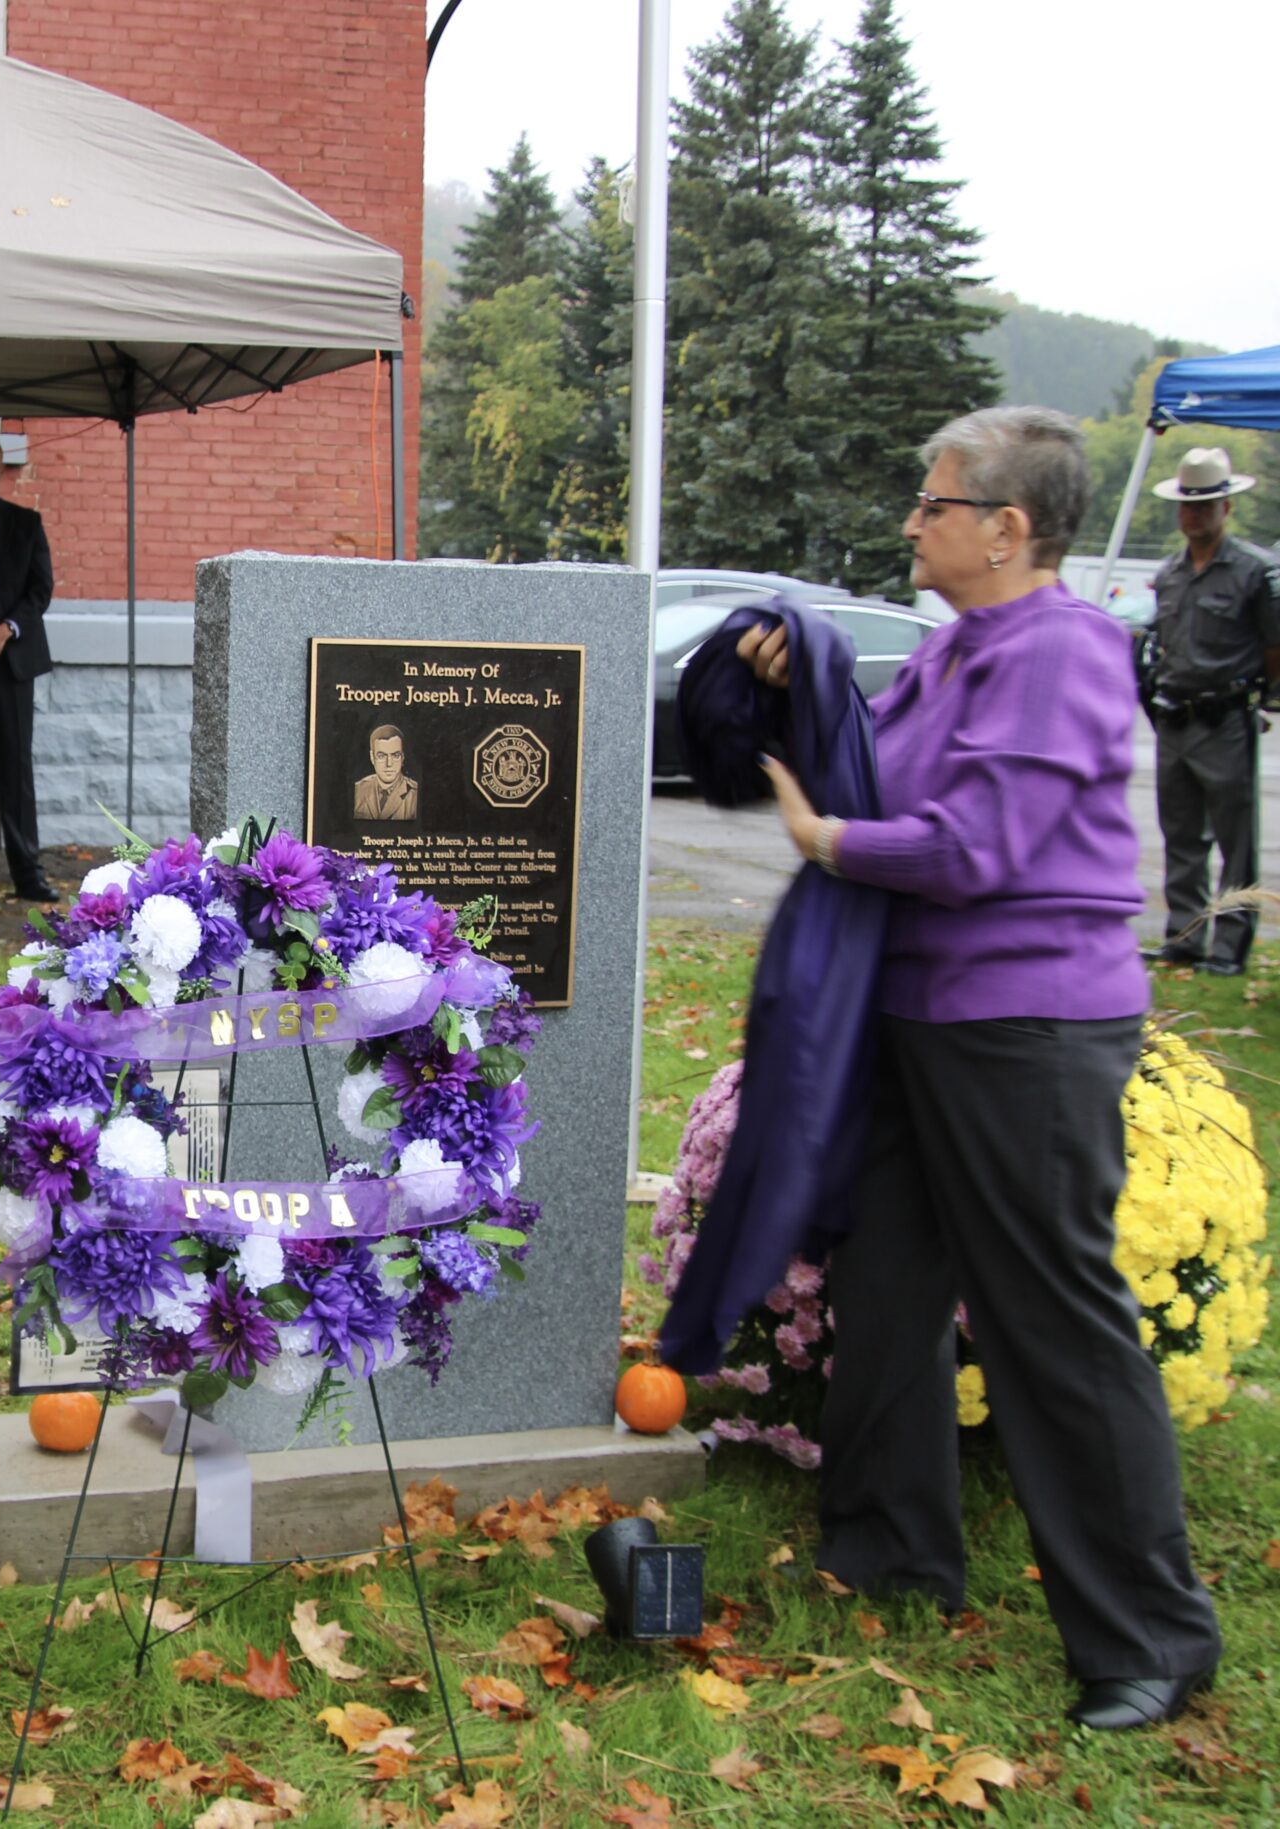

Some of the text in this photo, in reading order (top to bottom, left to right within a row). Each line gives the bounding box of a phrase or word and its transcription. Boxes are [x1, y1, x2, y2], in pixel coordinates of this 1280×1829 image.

[404, 662, 500, 680] In Memory Of
[336, 684, 561, 708] Trooper Joseph J. Mecca, Jr.
[491, 739, 533, 756] NEW YORK
[483, 762, 541, 774] N Y
[362, 836, 514, 848] Trooper Joseph Mecca, Jr., 62, died
[387, 849, 410, 859] 2020,
[433, 849, 456, 859] result
[458, 849, 468, 859] of
[498, 850, 535, 860] stemming
[537, 849, 556, 859] from
[394, 862, 557, 873] to the World Trade Center site following
[409, 875, 437, 885] attacks
[453, 875, 494, 886] September
[497, 876, 507, 885] 11,
[510, 875, 530, 884] 2001.
[511, 900, 543, 911] assigned
[500, 913, 559, 923] New York City
[504, 926, 530, 936] Detail.
[535, 964, 544, 974] he
[210, 1002, 337, 1046] NYSP
[329, 1194, 357, 1228] A
